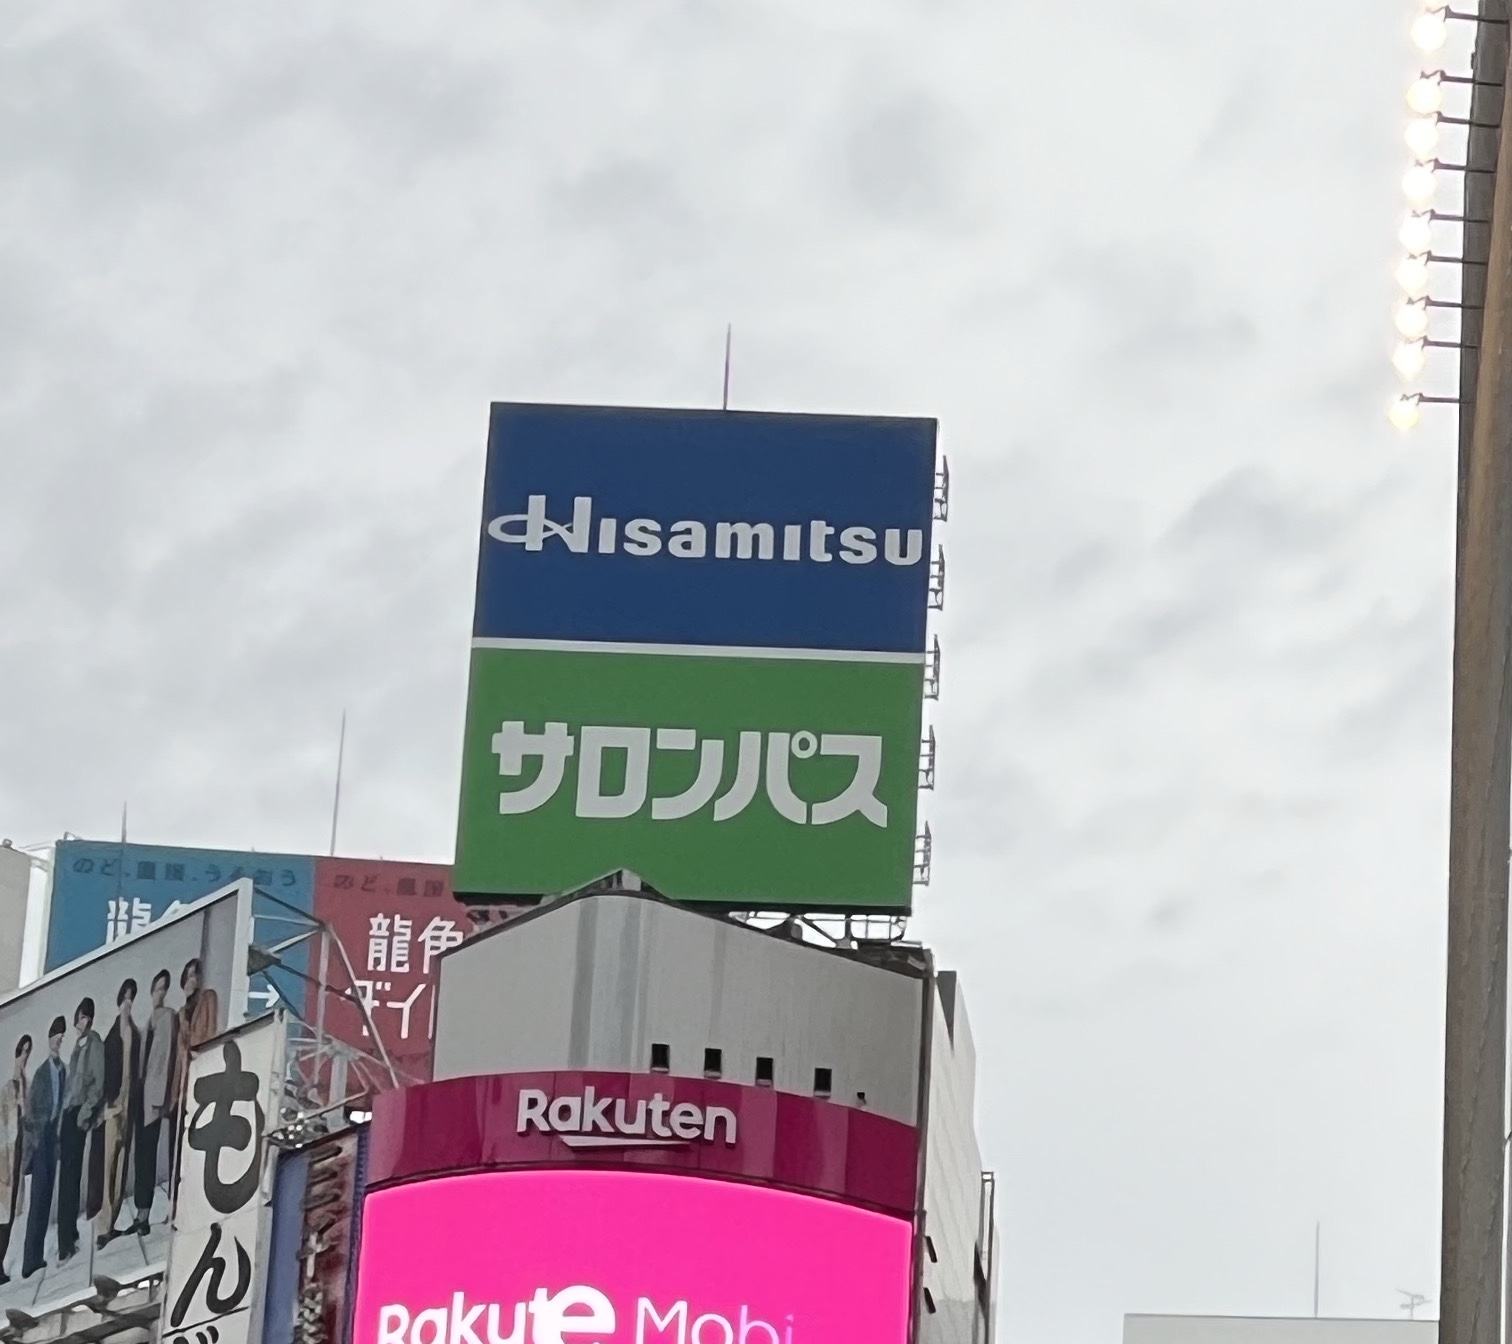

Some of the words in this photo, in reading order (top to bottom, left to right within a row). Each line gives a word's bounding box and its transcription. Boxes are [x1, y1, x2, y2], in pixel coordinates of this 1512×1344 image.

[488, 494, 923, 566] Hisamitsu
[491, 721, 888, 828] サロンパス
[516, 1085, 738, 1147] Rakuten
